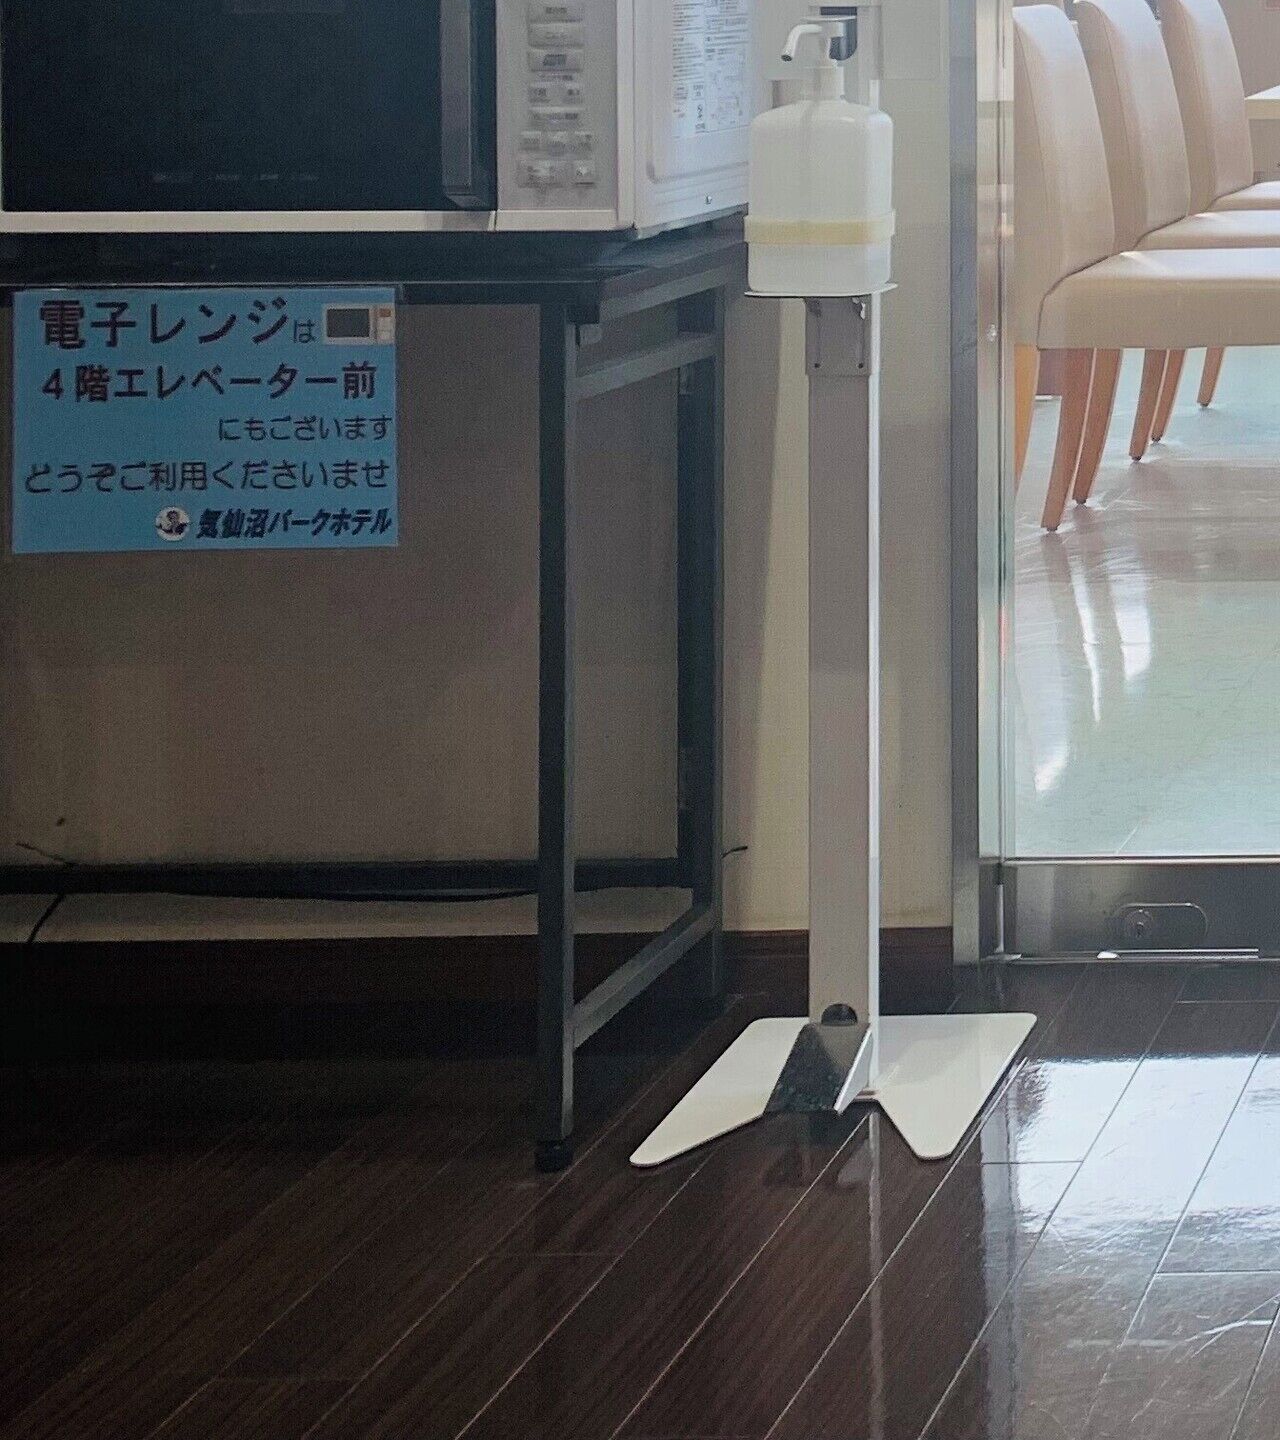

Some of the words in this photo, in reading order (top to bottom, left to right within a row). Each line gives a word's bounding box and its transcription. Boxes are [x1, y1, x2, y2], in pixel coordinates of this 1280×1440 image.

[38, 297, 317, 350] 電子レンジは
[41, 361, 377, 403] 4階エレベーター前
[218, 415, 393, 442] にもございます
[25, 459, 391, 495] どうぞご利用くださいませ
[194, 507, 393, 540] 気仙沼パークホテル
